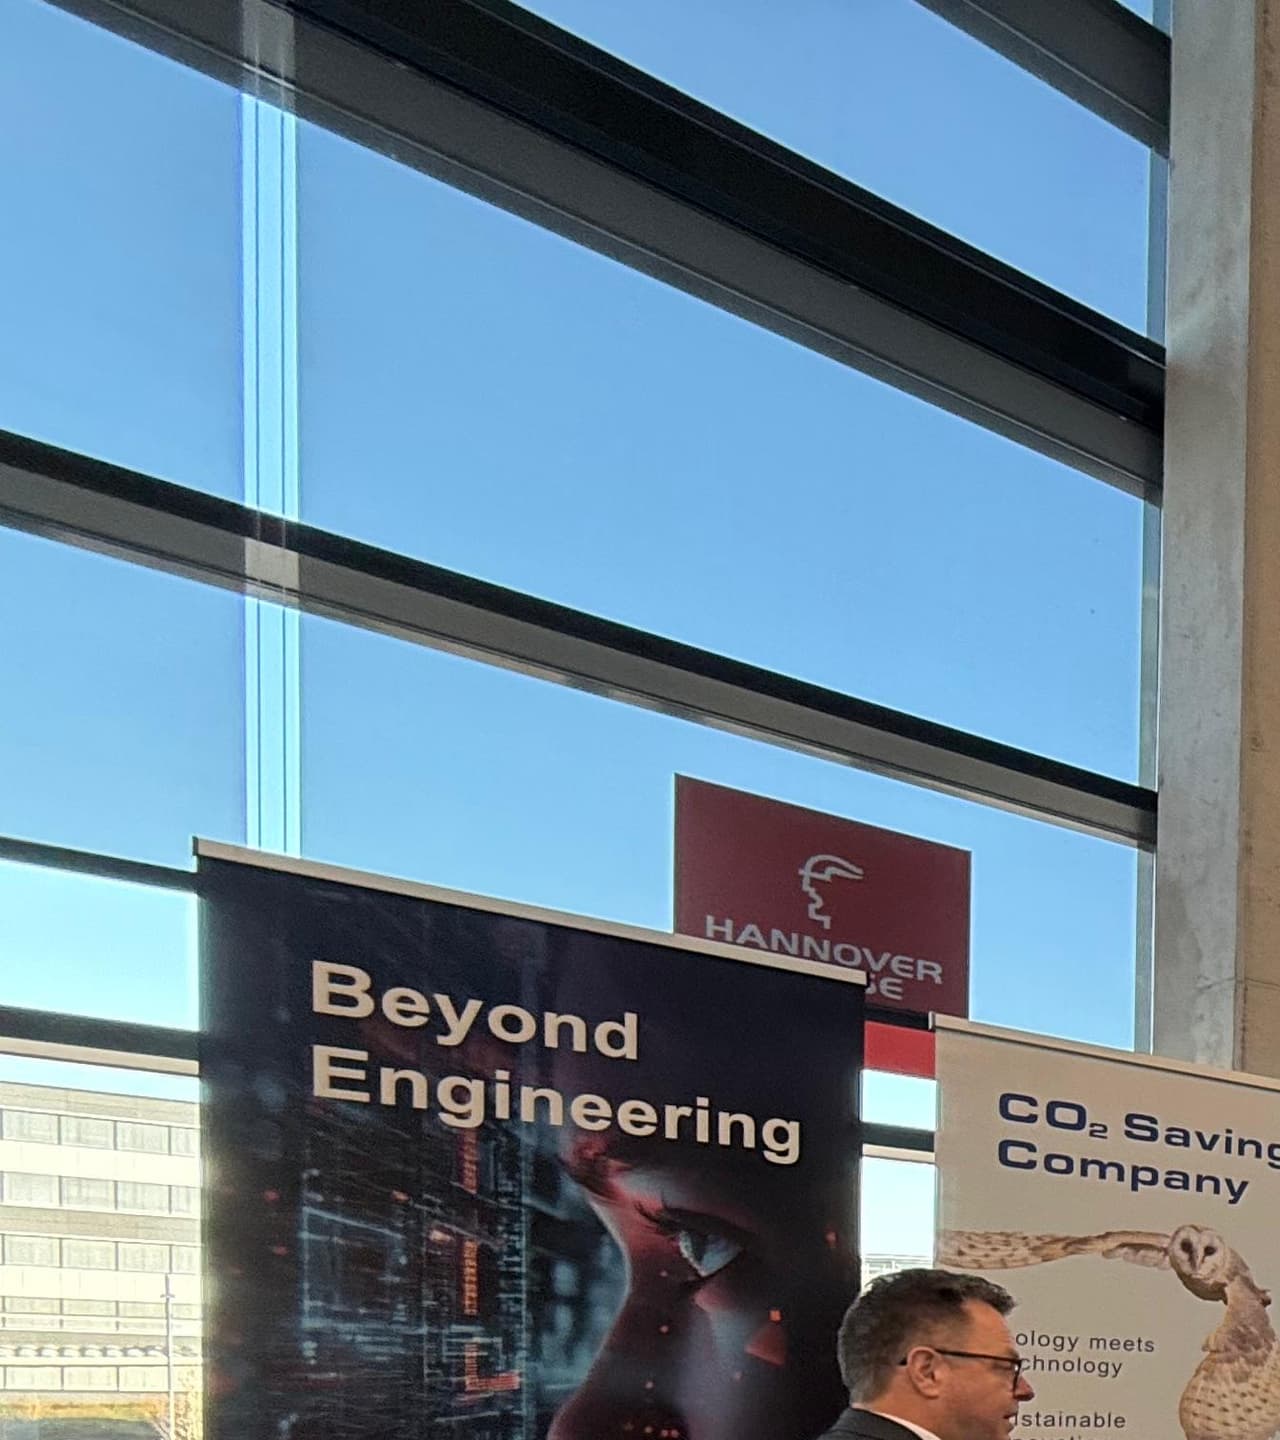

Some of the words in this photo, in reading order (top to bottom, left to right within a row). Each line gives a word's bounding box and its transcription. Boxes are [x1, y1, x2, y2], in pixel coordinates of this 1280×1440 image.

[704, 914, 943, 985] HANNOVER
[311, 959, 639, 1061] Beyond
[311, 1044, 802, 1166] Engineering
[997, 1138, 1250, 1205] Company
[1015, 1330, 1079, 1353] ology
[1089, 1336, 1155, 1352] meets
[1019, 1355, 1123, 1378] chnology
[1014, 1411, 1127, 1429] stainable
